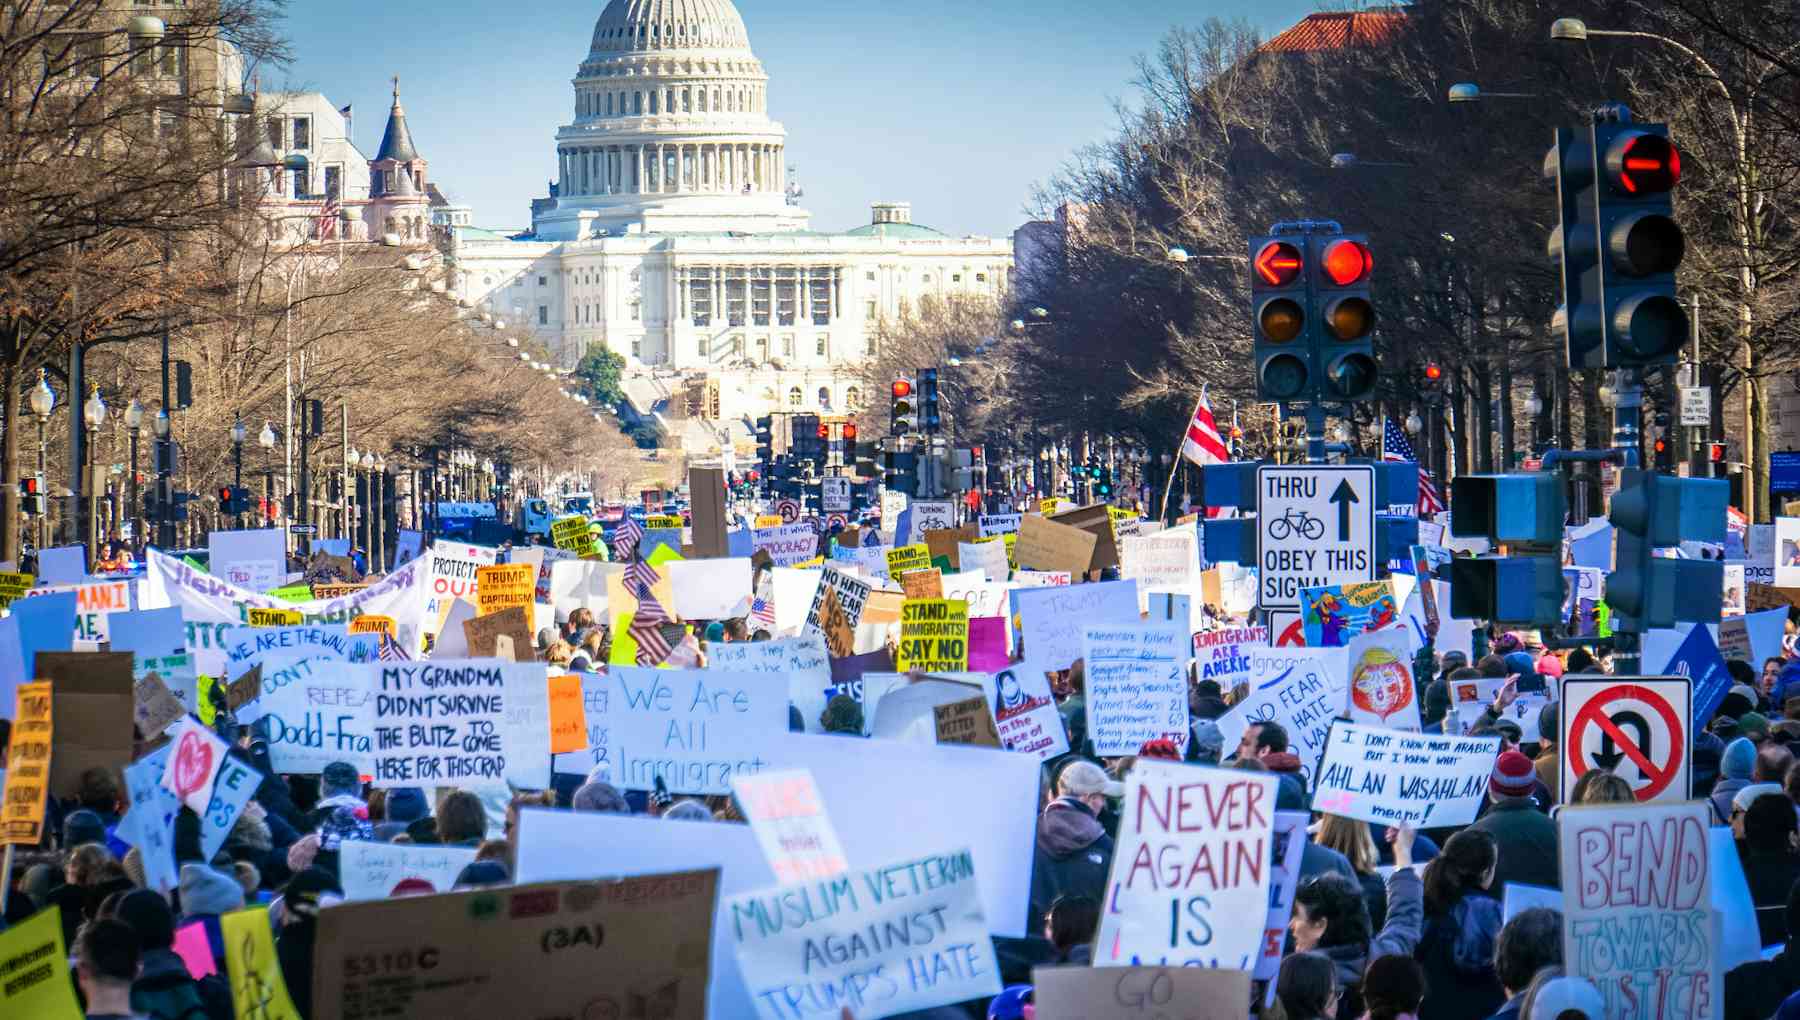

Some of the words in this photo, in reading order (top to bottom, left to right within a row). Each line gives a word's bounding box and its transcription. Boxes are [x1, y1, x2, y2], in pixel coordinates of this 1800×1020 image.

[1267, 476, 1317, 498] THRU
[920, 505, 945, 513] TURNING
[553, 519, 577, 529] STAND
[648, 518, 673, 528] STAND
[557, 537, 576, 551] SAY
[576, 534, 590, 545] NO
[888, 548, 917, 561] STAND
[1265, 551, 1316, 571] OBEY
[1326, 549, 1366, 571] THIS
[0, 575, 22, 583] TAND
[486, 570, 526, 585] TRUMP
[821, 567, 839, 585] NO
[840, 576, 868, 600] HATE
[481, 593, 533, 605] CAPITALISM
[251, 611, 286, 625] STAND
[903, 603, 948, 621] STAND
[354, 620, 389, 633] TRUMP
[902, 622, 966, 637] IMMIGRANTS!
[1194, 625, 1269, 649] IMMIGRANTS
[227, 643, 254, 662] WE
[255, 630, 293, 650] ARE
[901, 639, 933, 660] SAY
[937, 639, 964, 660] NO
[1212, 645, 1240, 659] ARE
[383, 666, 418, 691] MY
[420, 665, 504, 688] GRANDMA
[1203, 655, 1251, 679] AMERIC
[620, 671, 673, 712] We
[690, 679, 750, 713] Are
[1246, 702, 1276, 724] NO
[1279, 672, 1323, 709] FEAR
[439, 695, 503, 716] SURVIVE
[1291, 694, 1335, 730] HATE
[264, 712, 371, 753] Dodd-Fra
[375, 726, 403, 750] THE
[410, 722, 459, 749] BLITZ
[462, 734, 501, 753] COME
[468, 720, 494, 737] TO
[664, 718, 706, 751] All
[999, 725, 1009, 736] in
[1011, 716, 1032, 729] the
[1030, 724, 1043, 737] of
[1302, 723, 1330, 749] WA
[1343, 729, 1357, 743] I
[1400, 738, 1427, 750] KNOW
[1428, 741, 1451, 752] MUCH
[376, 757, 413, 780] HERE
[416, 755, 442, 779] FOR
[443, 757, 473, 778] THIS
[473, 757, 506, 779] CRAP
[621, 747, 768, 786] Immigrant
[1364, 750, 1387, 762] BUT
[1391, 752, 1402, 764] I
[1404, 755, 1432, 764] KNOW
[1320, 761, 1388, 796] AHLAN
[1398, 773, 1490, 801] WASAHLAN
[1136, 781, 1268, 834] NEVER
[1371, 802, 1436, 824] means!
[1125, 838, 1264, 891] AGAIN
[1576, 816, 1708, 911] BEND
[732, 872, 860, 942] MUSLIM
[863, 849, 976, 905] VETERAN
[1169, 896, 1213, 948] IS
[539, 922, 605, 953] (3A)
[802, 904, 948, 976] AGAINST
[1572, 911, 1708, 976] TOWARDS
[906, 943, 985, 993] HATE
[1115, 969, 1175, 1010] GO
[1598, 970, 1710, 1020] USTICE
